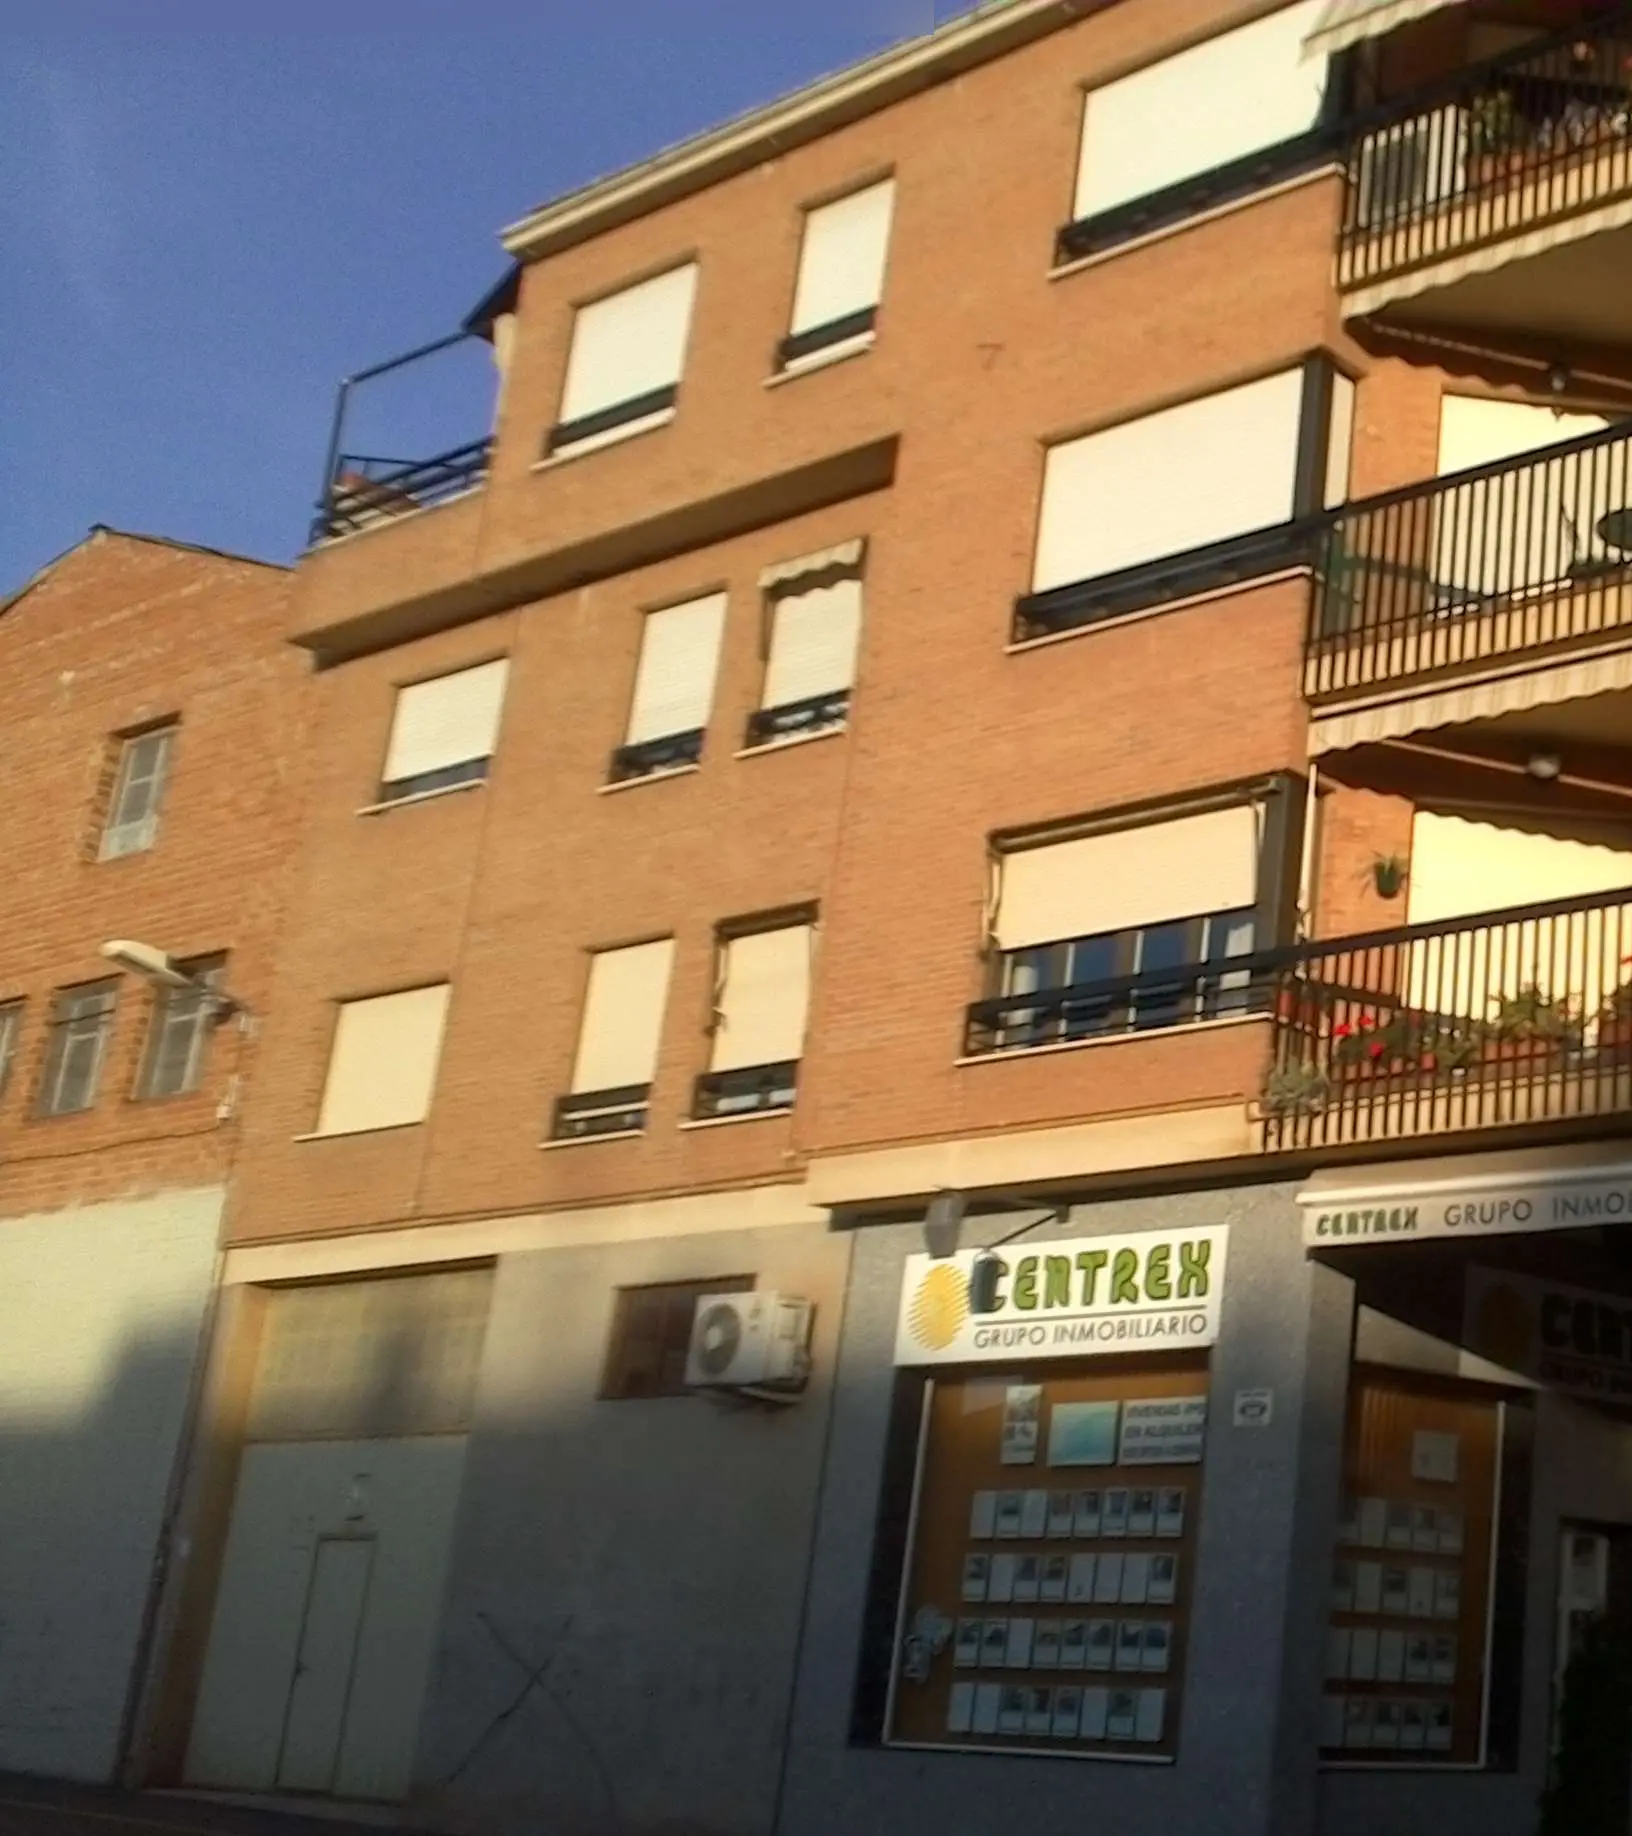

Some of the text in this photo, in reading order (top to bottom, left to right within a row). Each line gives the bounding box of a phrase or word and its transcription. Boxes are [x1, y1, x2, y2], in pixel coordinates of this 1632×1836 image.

[1315, 1206, 1419, 1236] CENTREX
[1444, 1198, 1533, 1227] GRUPO
[973, 1313, 1207, 1349] GRUPO INMOBILIARIO
